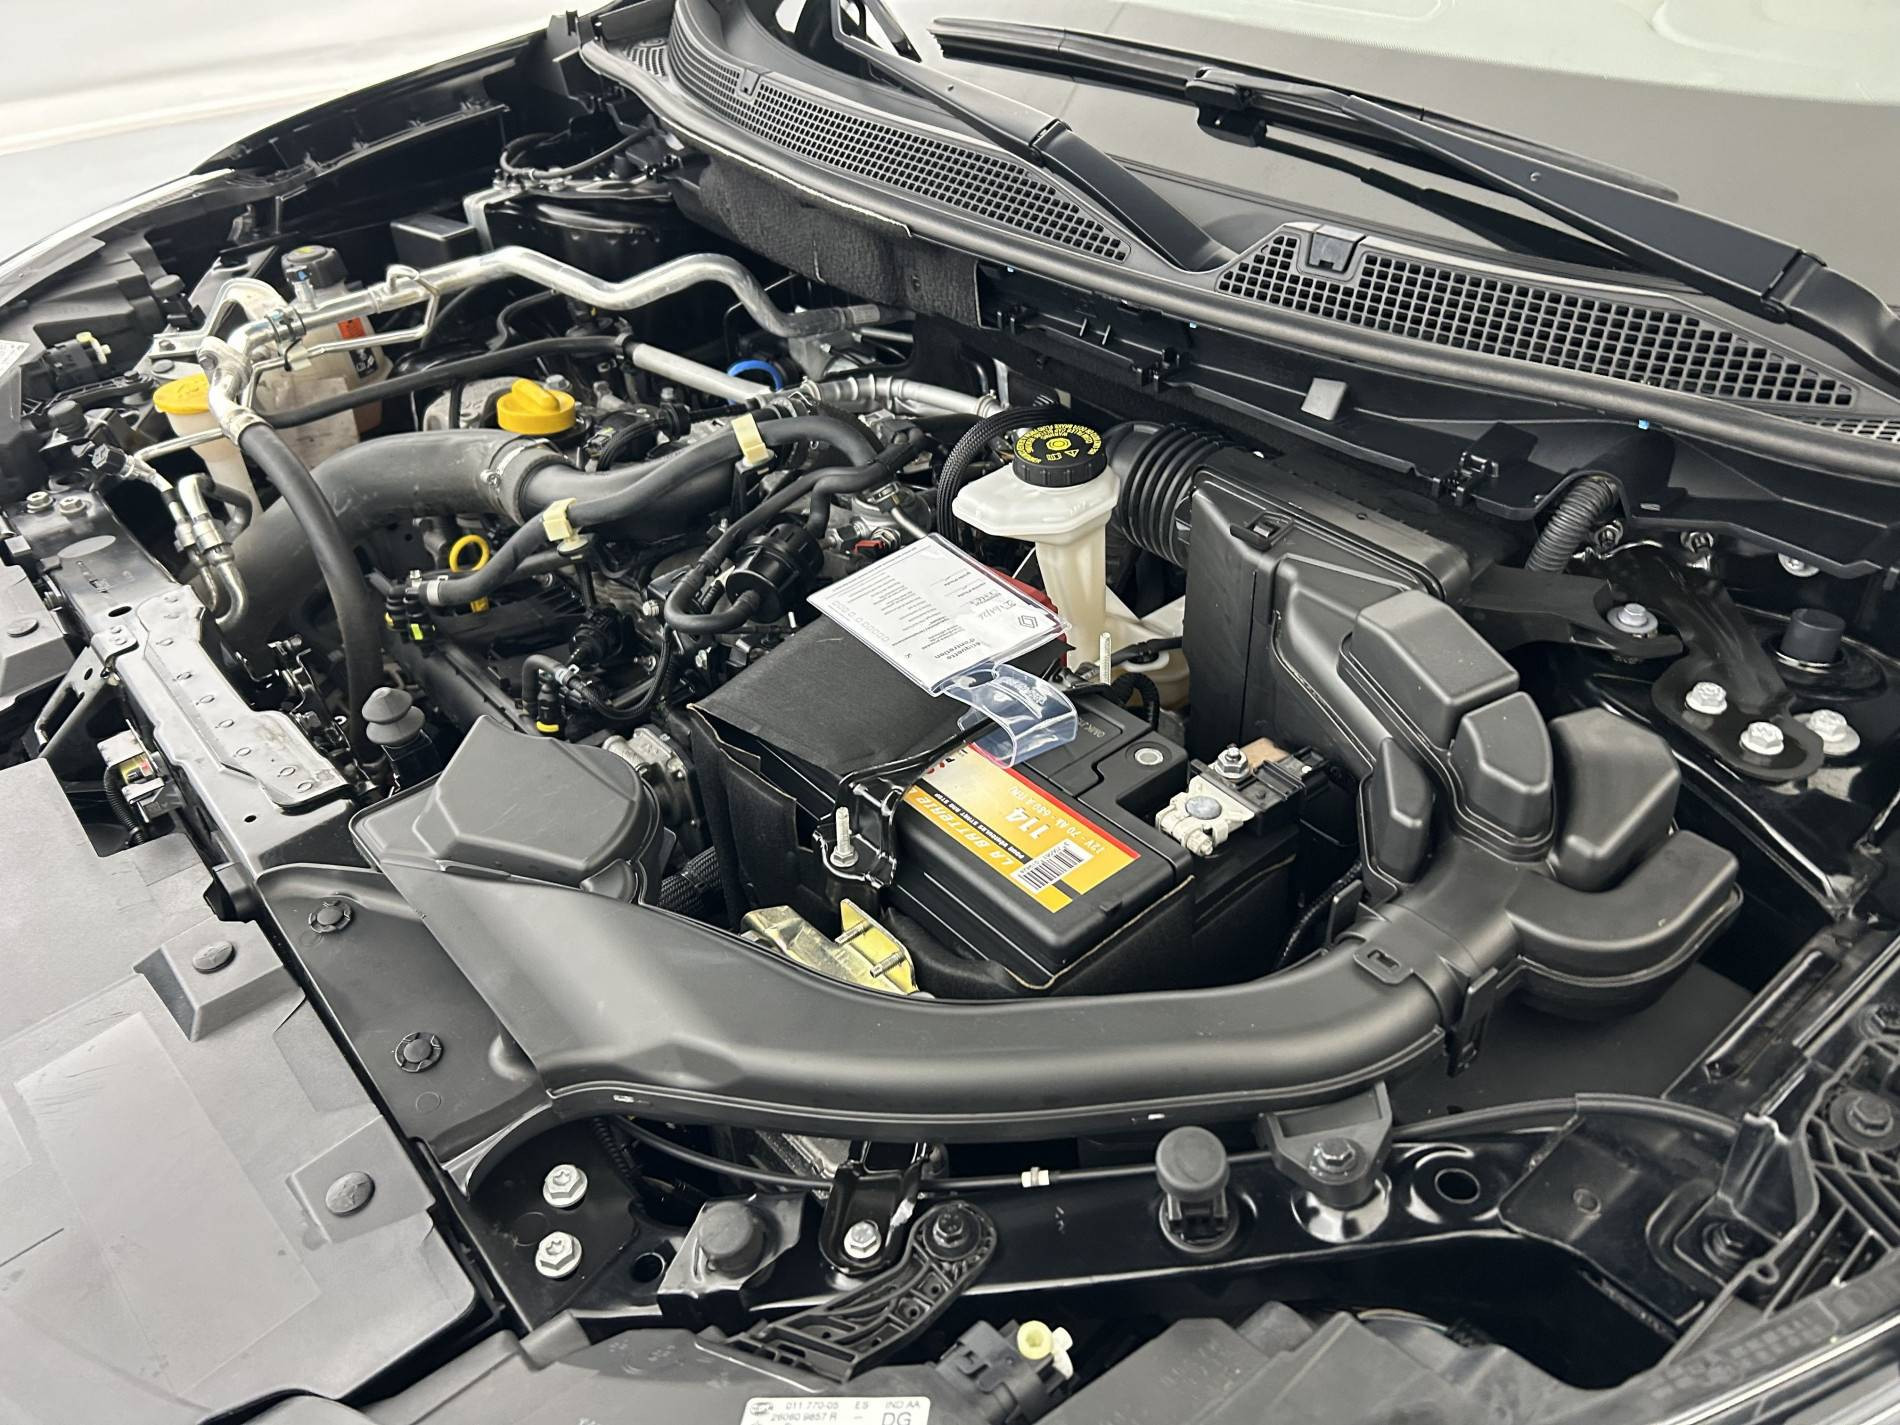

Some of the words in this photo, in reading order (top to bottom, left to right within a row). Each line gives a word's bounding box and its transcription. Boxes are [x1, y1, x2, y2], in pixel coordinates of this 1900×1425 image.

[934, 793, 949, 804] STOP
[961, 811, 979, 826] START
[1006, 807, 1050, 840] 114
[991, 850, 1015, 866] LA
[882, 1412, 912, 1425] DG
